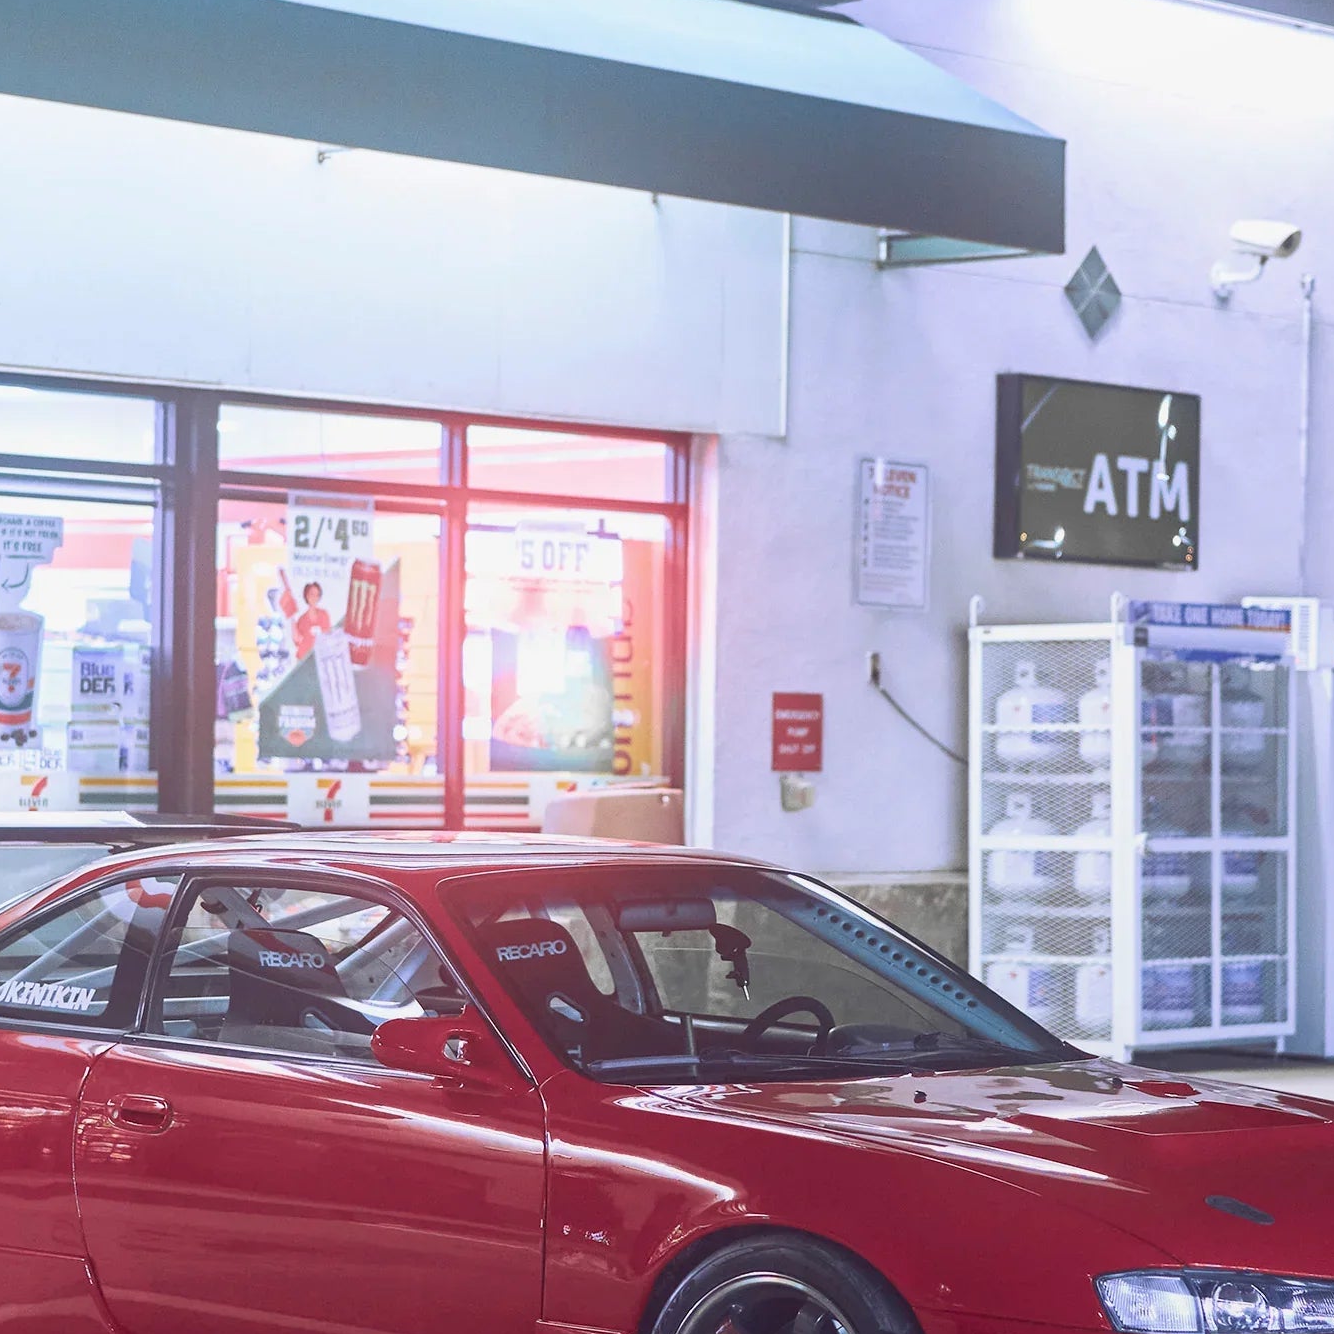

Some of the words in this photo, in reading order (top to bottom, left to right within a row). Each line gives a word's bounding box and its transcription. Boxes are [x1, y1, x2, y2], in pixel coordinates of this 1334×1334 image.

[1083, 453, 1190, 522] ATM
[542, 540, 588, 571] OFF
[80, 662, 115, 676] Blue
[258, 950, 325, 968] RECARO
[496, 939, 568, 962] RECARO
